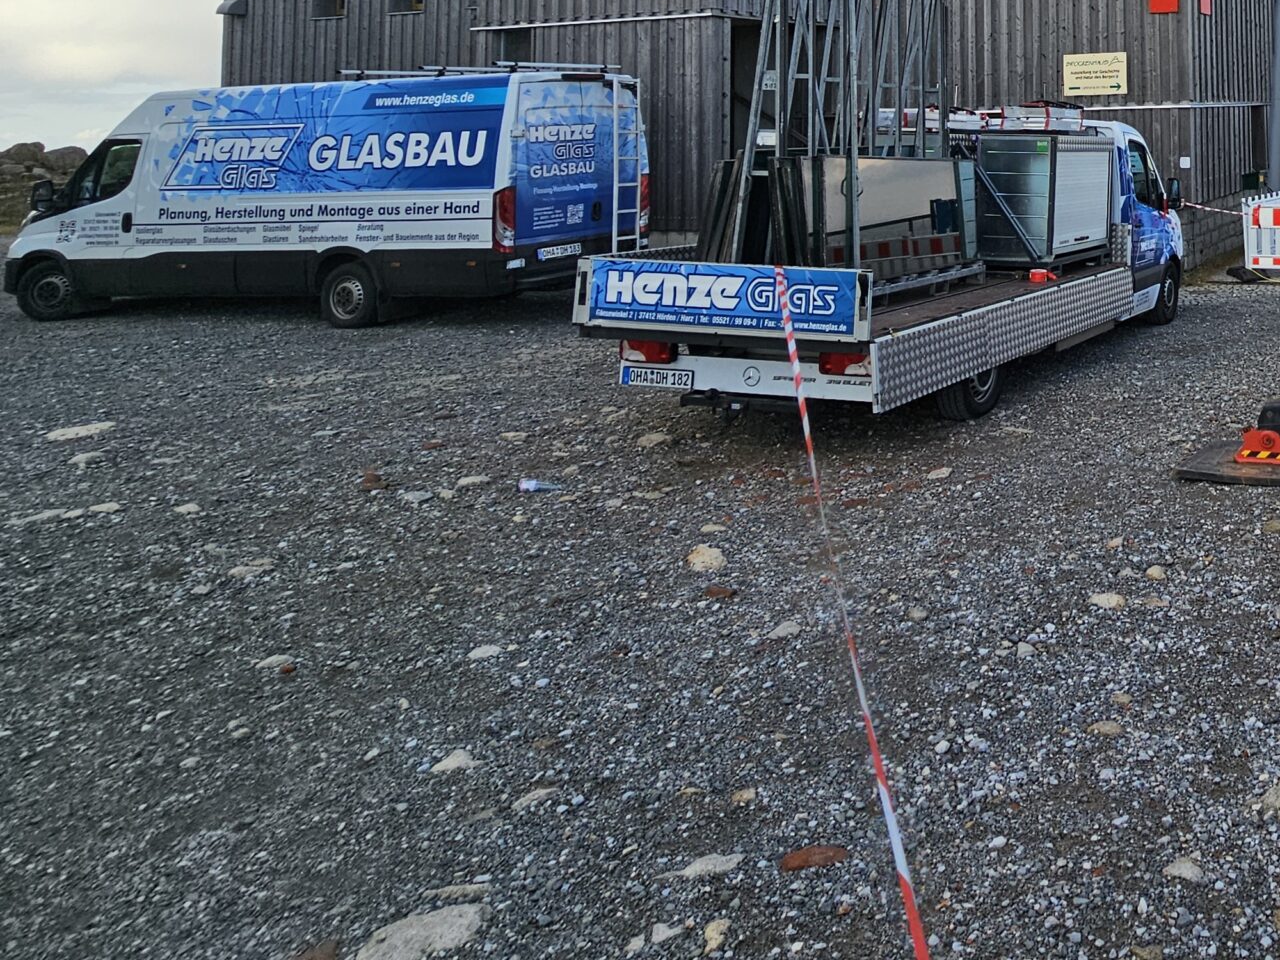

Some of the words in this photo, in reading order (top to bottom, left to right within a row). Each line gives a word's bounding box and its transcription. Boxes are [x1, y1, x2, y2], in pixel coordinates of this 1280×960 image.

[375, 92, 474, 107] www.henzeglas.de
[529, 124, 596, 142] Henze
[193, 136, 289, 163] Henze
[308, 130, 488, 172] GLASBAU
[219, 165, 280, 189] Glas
[530, 161, 595, 178] GLASBAU
[158, 208, 212, 222] Planung,
[215, 205, 286, 220] Herstellung
[290, 204, 313, 217] und
[317, 206, 374, 219] Montage
[377, 206, 400, 215] aus
[404, 203, 439, 215] einer
[443, 201, 480, 214] Hand
[605, 270, 746, 309] Henze
[638, 312, 656, 320] 37412
[656, 312, 676, 321] Hörden
[712, 316, 729, 324] 05521
[734, 317, 742, 325] 99
[743, 318, 757, 326] 09-0
[793, 320, 847, 332] www.henzeglas.de
[629, 369, 649, 385] OHA
[655, 372, 668, 386] DH
[671, 372, 690, 388] 182
